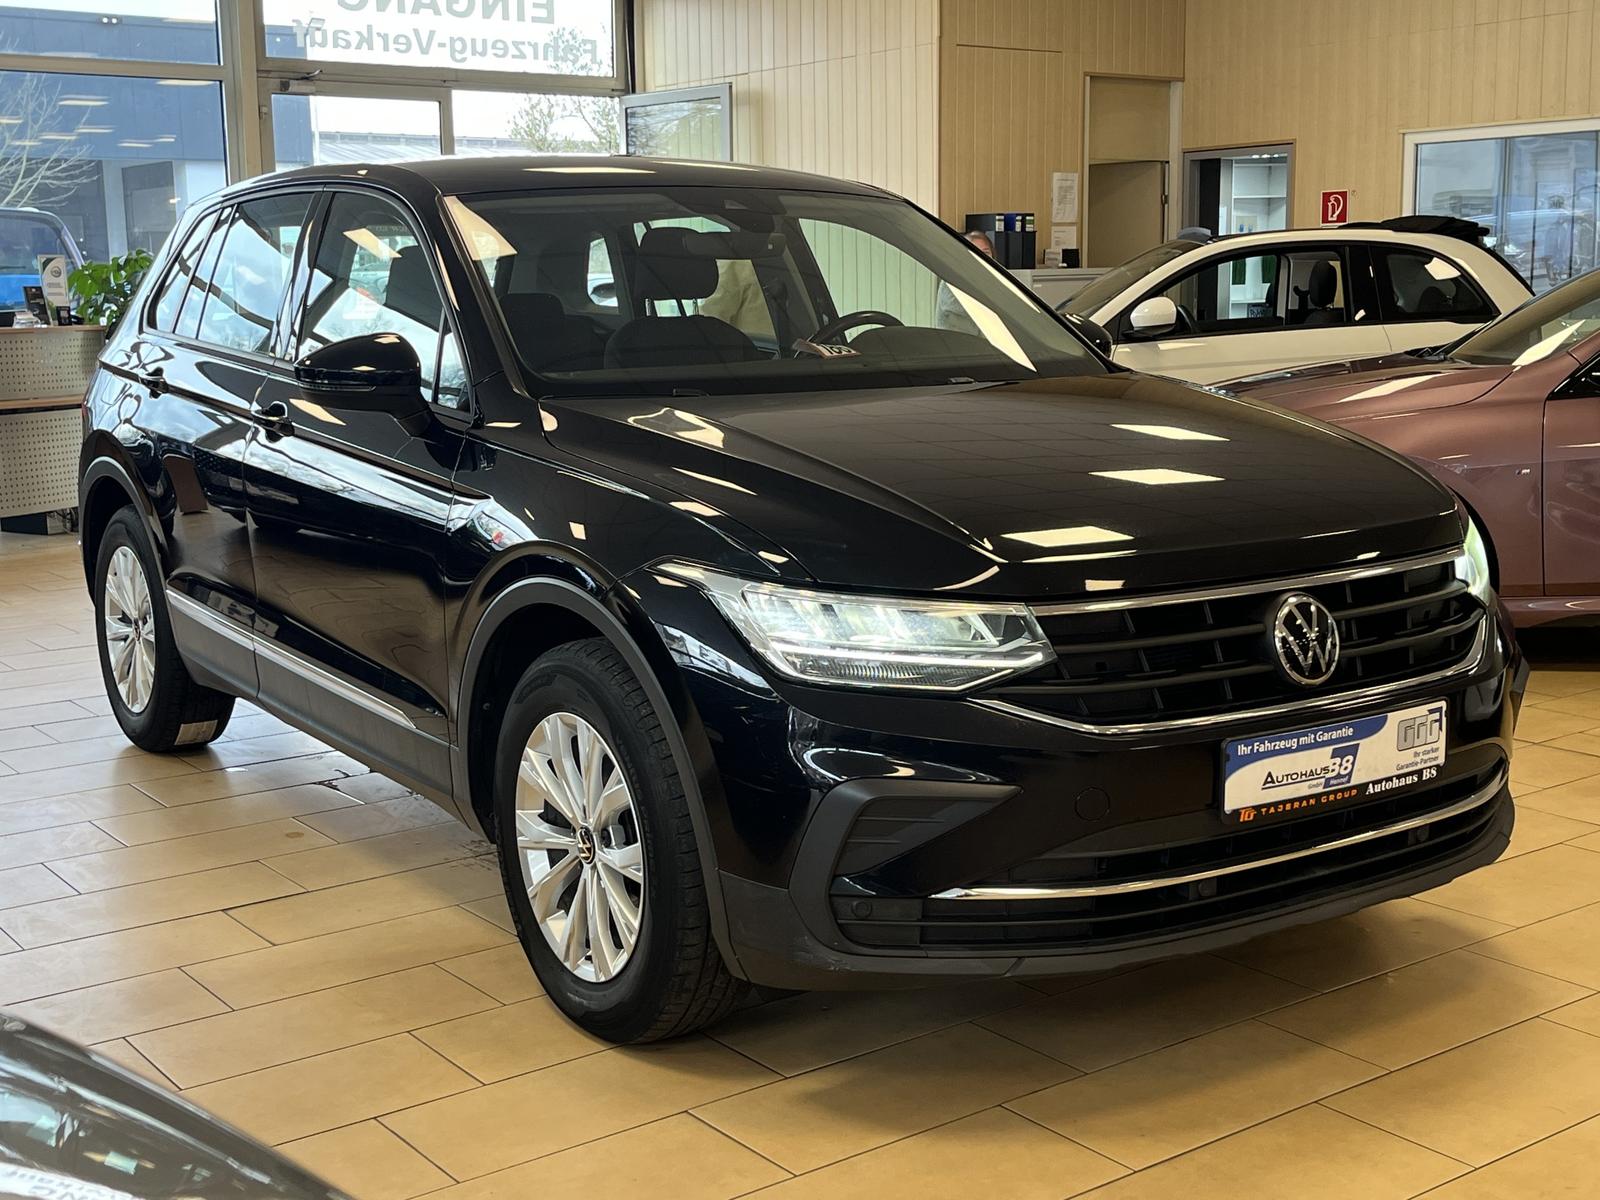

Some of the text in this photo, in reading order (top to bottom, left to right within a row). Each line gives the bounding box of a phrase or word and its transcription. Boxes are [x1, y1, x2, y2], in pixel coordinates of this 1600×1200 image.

[1237, 726, 1354, 756] Ihr Fahrzeug mit Garantie
[1395, 755, 1440, 771] Garantie-Partner
[1262, 766, 1329, 787] AUTOHAUS
[1365, 774, 1418, 796] Autohaus
[1321, 789, 1358, 803] GROUP
